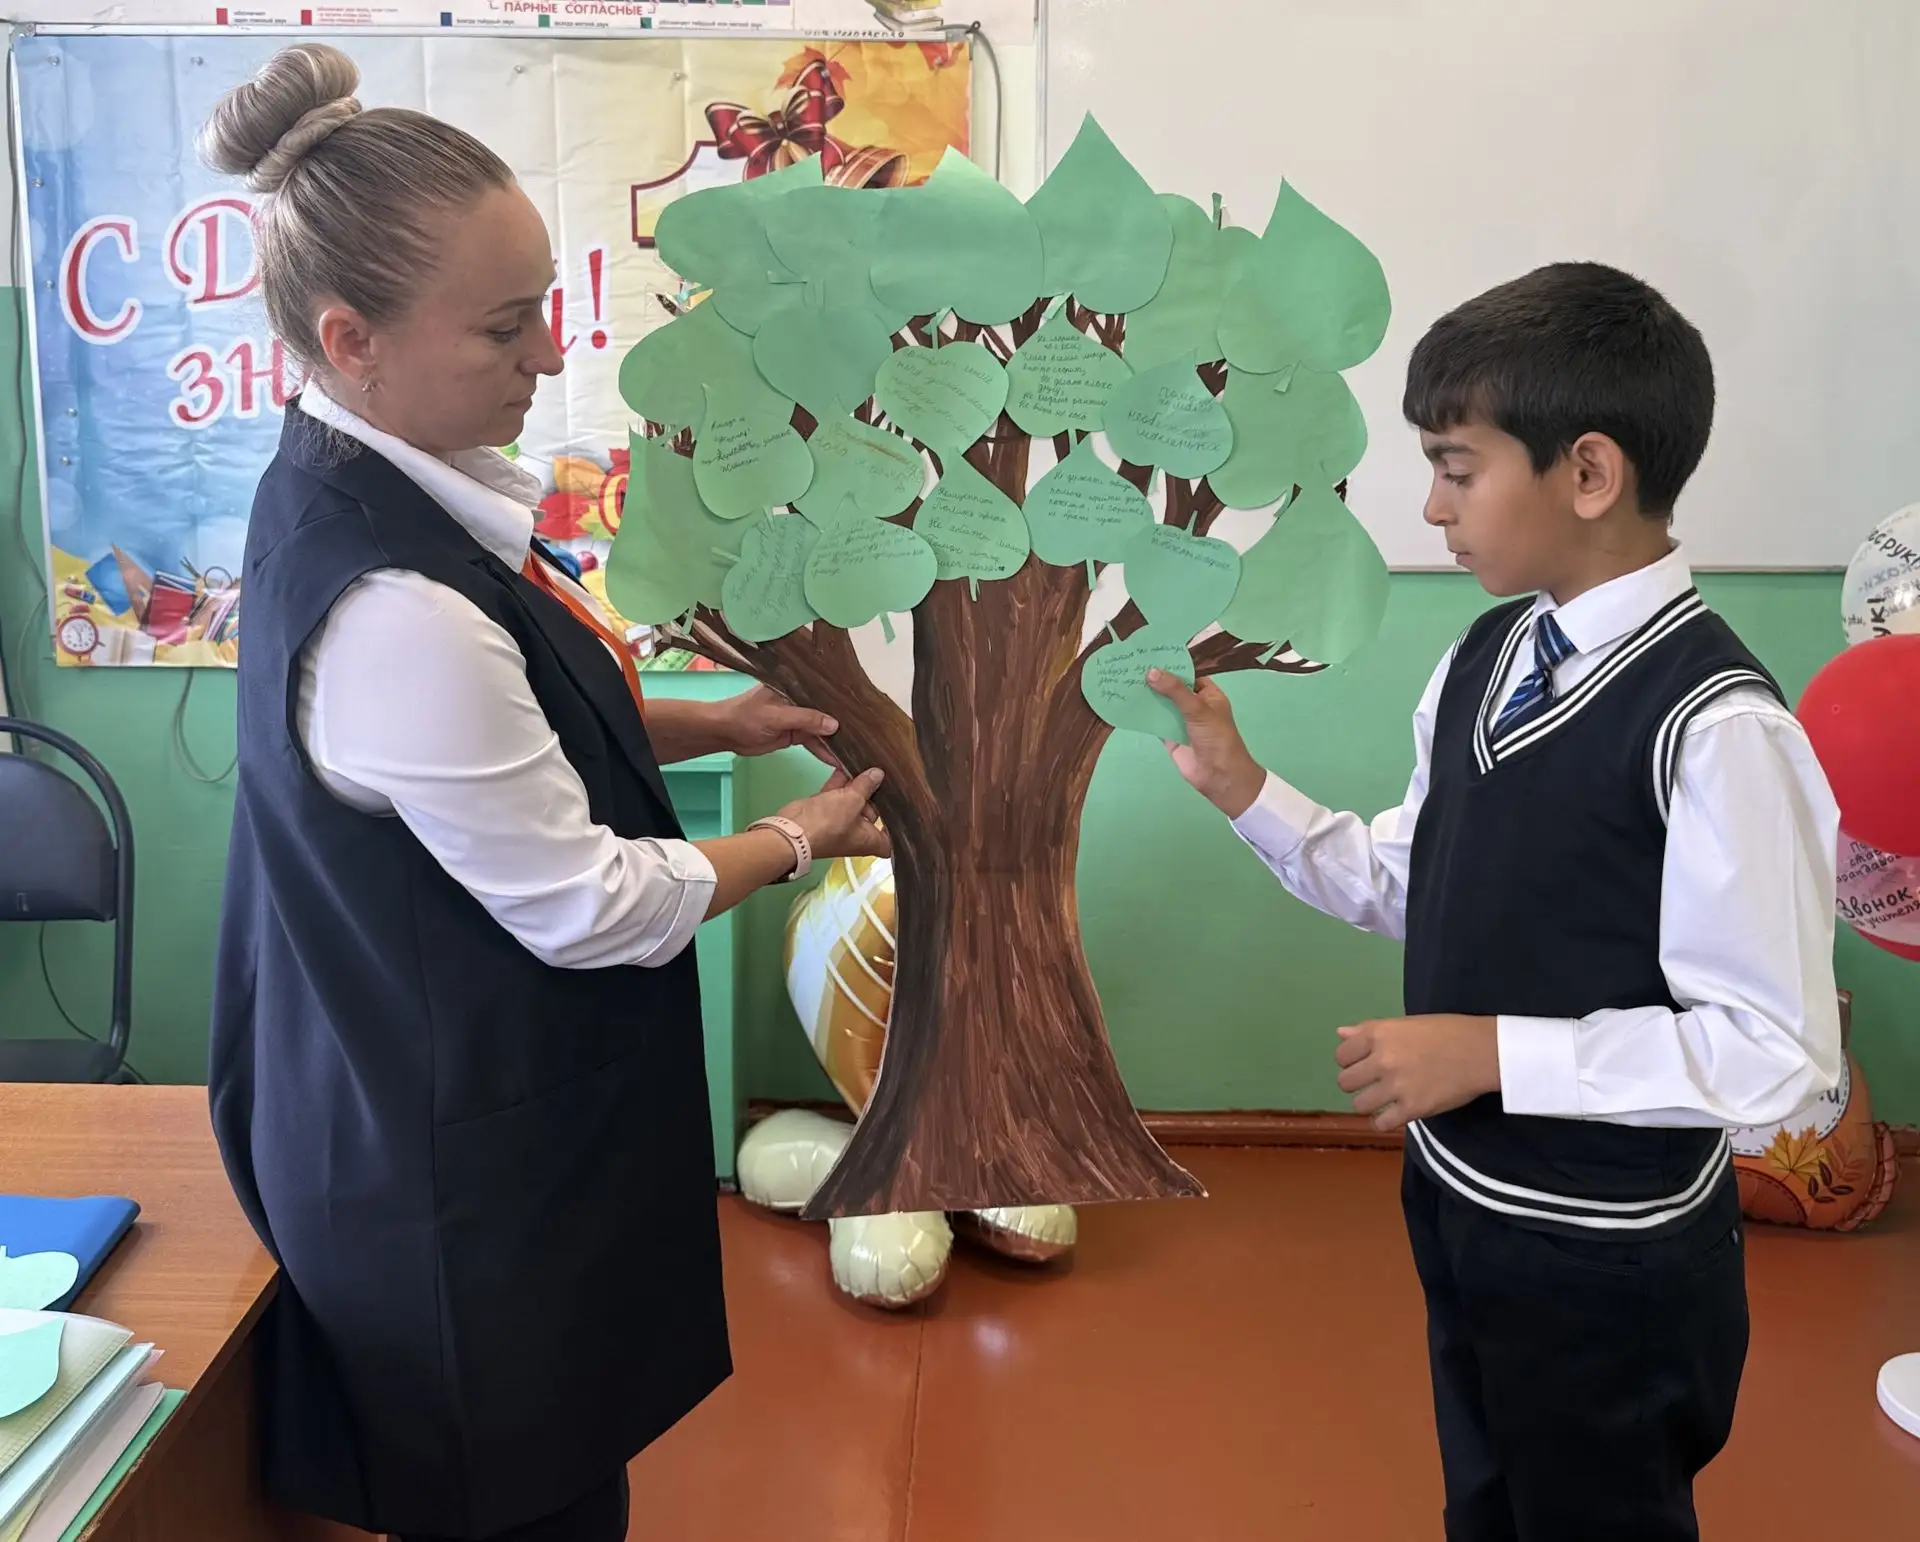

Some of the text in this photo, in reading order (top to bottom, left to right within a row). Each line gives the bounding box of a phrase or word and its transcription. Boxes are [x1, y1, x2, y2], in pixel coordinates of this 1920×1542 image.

[504, 2, 642, 16] ПАРНЫЕ СОГЛАСНЫЕ
[65, 220, 138, 339] С
